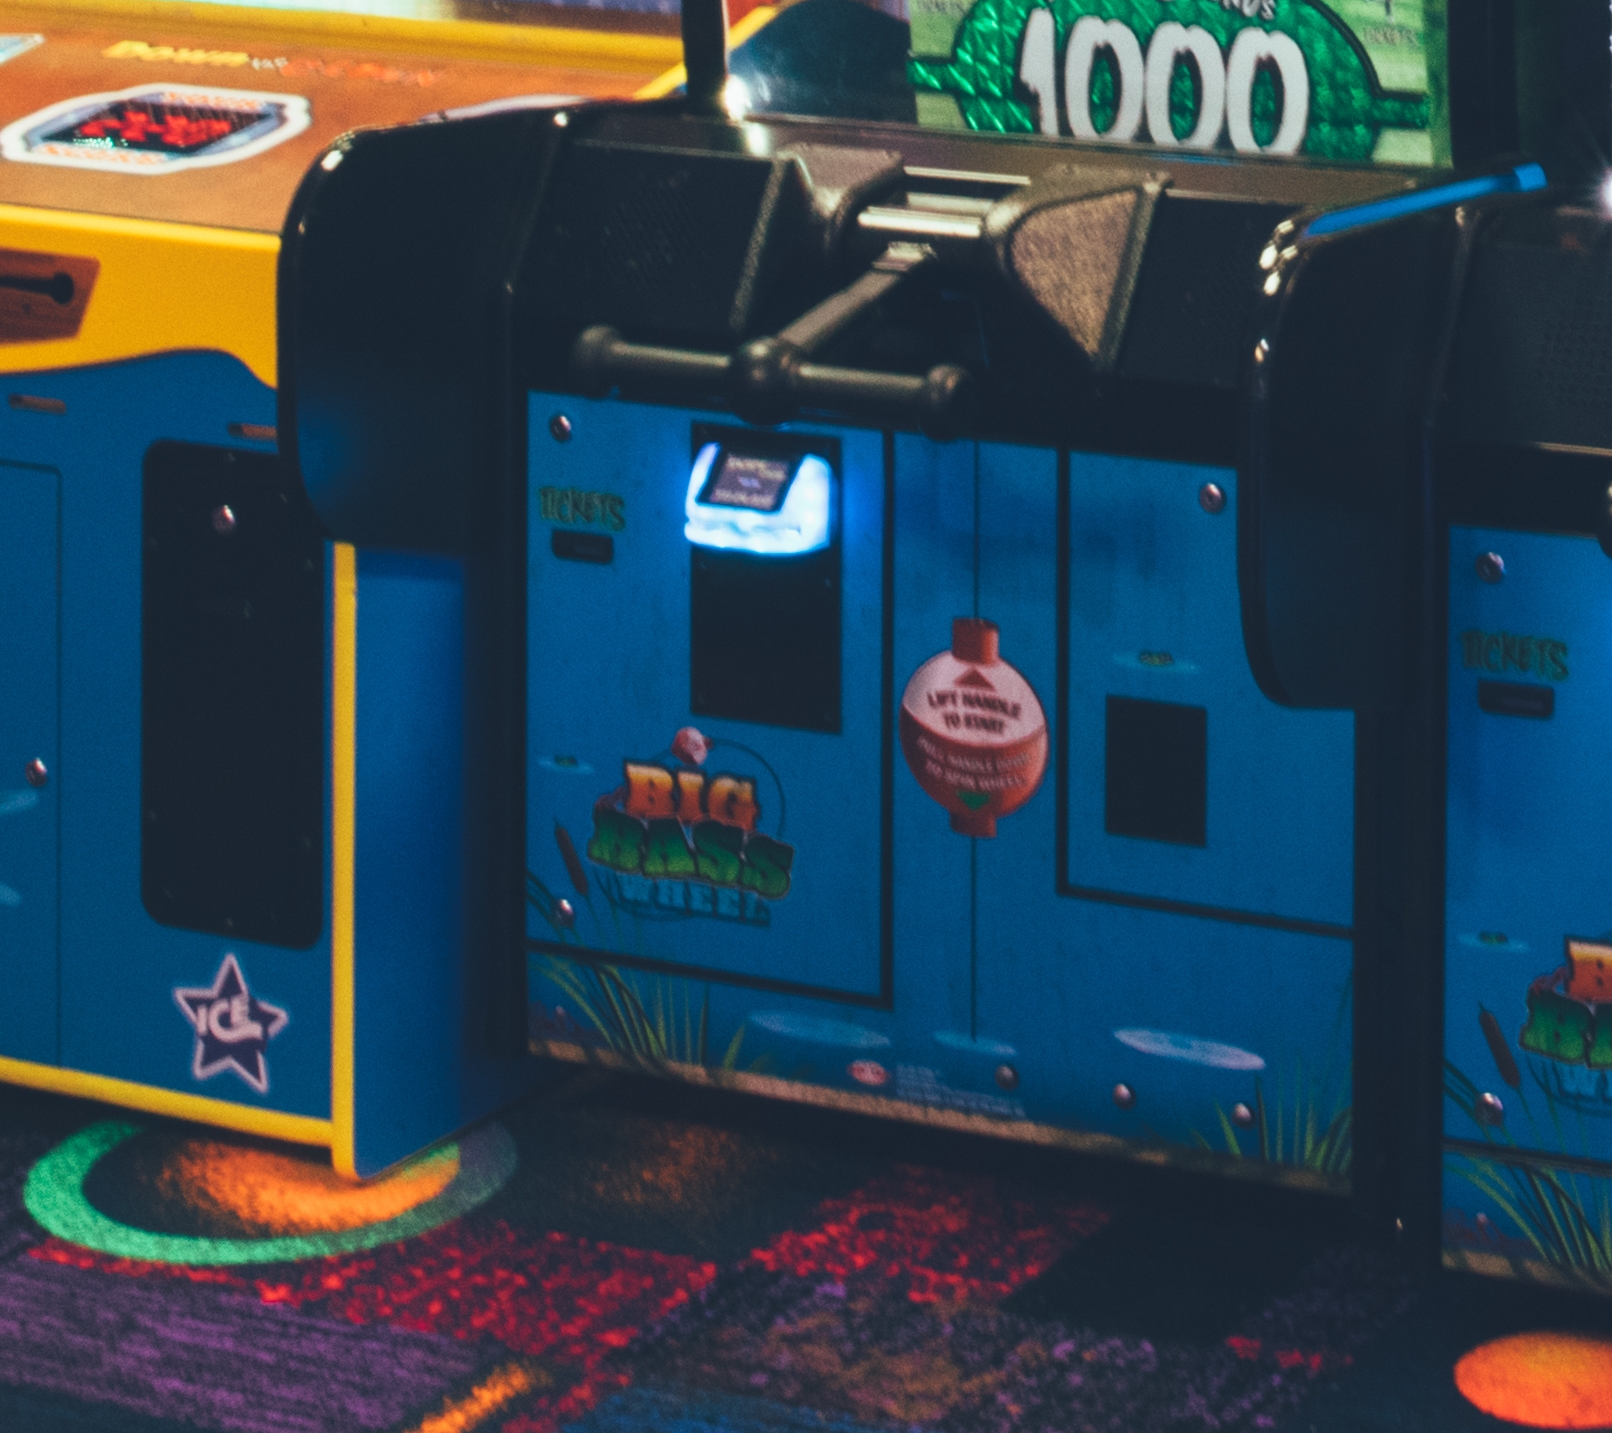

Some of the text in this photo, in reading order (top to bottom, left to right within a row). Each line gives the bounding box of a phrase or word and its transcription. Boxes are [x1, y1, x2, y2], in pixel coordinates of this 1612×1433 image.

[1020, 6, 1312, 160] 1000
[624, 761, 760, 831] BIG
[588, 806, 795, 902] BASS
